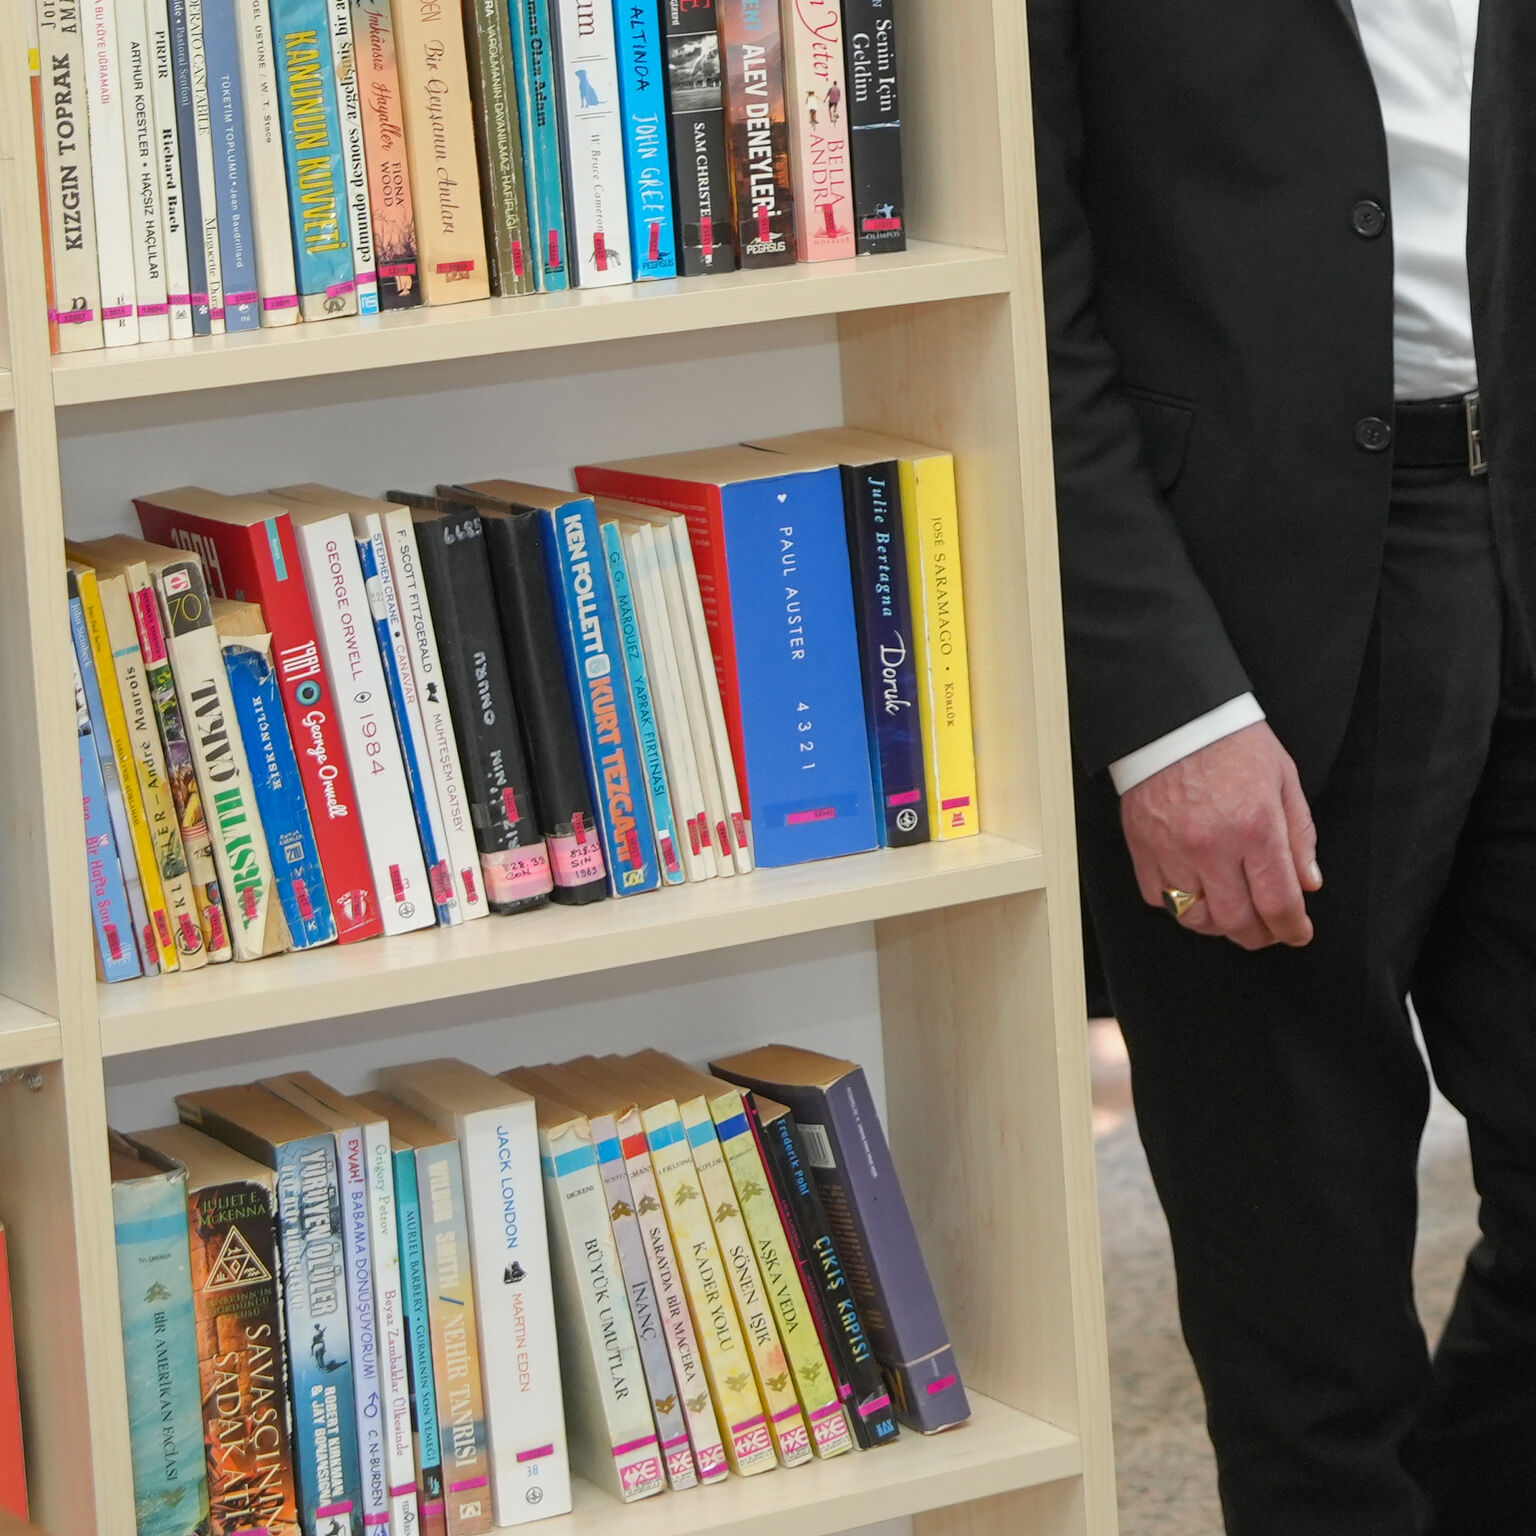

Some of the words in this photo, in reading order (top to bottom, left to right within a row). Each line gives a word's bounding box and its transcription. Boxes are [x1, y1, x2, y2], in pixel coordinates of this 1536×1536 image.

[95, 6, 104, 21] BU
[335, 15, 350, 37] bir
[131, 41, 143, 90] ARTHUR
[156, 30, 168, 79] PIRPIR
[175, 27, 188, 66] Pastoral
[424, 40, 445, 72] Bir
[631, 6, 651, 91] ALTINDA
[742, 44, 769, 97] ALEV
[852, 33, 873, 103] Geldim
[876, 19, 894, 71] Senin
[52, 52, 76, 156] TOPRAK
[284, 30, 329, 151] KANUNUN
[368, 81, 402, 151] Hayaller
[486, 25, 502, 101] VAROLMANIN
[494, 102, 511, 172] DAYANILMAZ
[534, 80, 547, 128] Adam
[135, 94, 149, 157] KOESTLER
[224, 126, 236, 180] TOPLUMU
[632, 112, 659, 160] JOHN
[693, 122, 708, 153] SAM
[163, 128, 176, 189] Richard
[193, 54, 209, 136] CANTABILE
[205, 217, 217, 277] Marguerite
[380, 161, 394, 207] WOOD
[392, 162, 404, 206] FIONA
[591, 150, 601, 180] Bruce
[827, 139, 846, 206] BELLA
[61, 165, 82, 251] KIZGIN
[141, 173, 154, 216] HAÇSIZ
[168, 196, 180, 233] Bach
[228, 186, 238, 212] Jean
[297, 156, 348, 254] KUVVETİ
[594, 184, 605, 231] Cameron
[145, 221, 159, 279] HAÇLILAR
[232, 214, 244, 268] Baudrillard
[355, 193, 371, 262] edmundo
[746, 241, 786, 255] PEGASUS
[868, 477, 887, 523] Julie
[563, 514, 588, 562] KEN
[779, 526, 796, 577] PAUL
[931, 517, 945, 547] JOSÉ
[875, 532, 892, 617] Bertagna
[167, 593, 201, 629] 70
[373, 532, 391, 584] STEPHEN
[384, 586, 400, 625] CRANE
[394, 644, 416, 705] CANAVAR
[572, 561, 604, 653] FOLLETT
[785, 587, 805, 660] AUSTER
[934, 553, 952, 656] SARAMAGO
[326, 541, 350, 609] GEORGE
[340, 613, 363, 681] ORWELL
[360, 713, 385, 776] 1984
[879, 630, 911, 716] Doruk
[126, 666, 147, 731] Maurois
[400, 543, 418, 589] SCOTT
[409, 591, 432, 674] FITZGERALD
[447, 784, 465, 833] GATSBY
[589, 678, 622, 745] KURT
[633, 675, 653, 727] YAPRAK
[644, 731, 665, 796] FIRTINASI
[140, 741, 159, 789] André
[301, 710, 328, 766] George
[319, 765, 348, 820] Orwell
[348, 1139, 364, 1184] EYVAH!
[373, 1144, 387, 1192] Grigory
[496, 1125, 512, 1173] JACK
[202, 1194, 245, 1213] JULIET
[301, 1148, 336, 1241] YÜRÜYEN
[351, 1191, 367, 1255] BABAMA
[378, 1196, 390, 1235] Petrov
[501, 1177, 519, 1250] LONDON
[407, 1210, 419, 1258] MURIEL
[650, 1227, 674, 1292] SARAYDA
[410, 1261, 426, 1313] BARBERY
[693, 1242, 720, 1304] KADER
[711, 1305, 735, 1352] YOLU
[729, 1246, 758, 1306] SÖNEN
[759, 1240, 782, 1284] AŞKA
[777, 1288, 799, 1332] VEDA
[812, 1235, 846, 1290] ÇIKIŞ
[837, 1298, 871, 1363] KAPISI
[384, 1290, 396, 1326] Beyaz
[512, 1293, 528, 1349] MARTIN
[584, 1238, 610, 1303] BÜYÜK
[599, 1307, 629, 1400] UMUTLAR
[632, 1281, 657, 1342] İNANÇ
[667, 1295, 681, 1318] BİR
[387, 1329, 404, 1394] Zambaklar
[444, 1312, 472, 1381] NEHİR
[517, 1353, 531, 1394] EDEN
[672, 1321, 697, 1383] MACERA
[312, 1400, 326, 1425] JAY
[325, 1385, 340, 1436] ROBERT
[421, 1391, 430, 1414] SON
[450, 1384, 478, 1468] TANRISI
[328, 1437, 344, 1497] KIRKMAN
